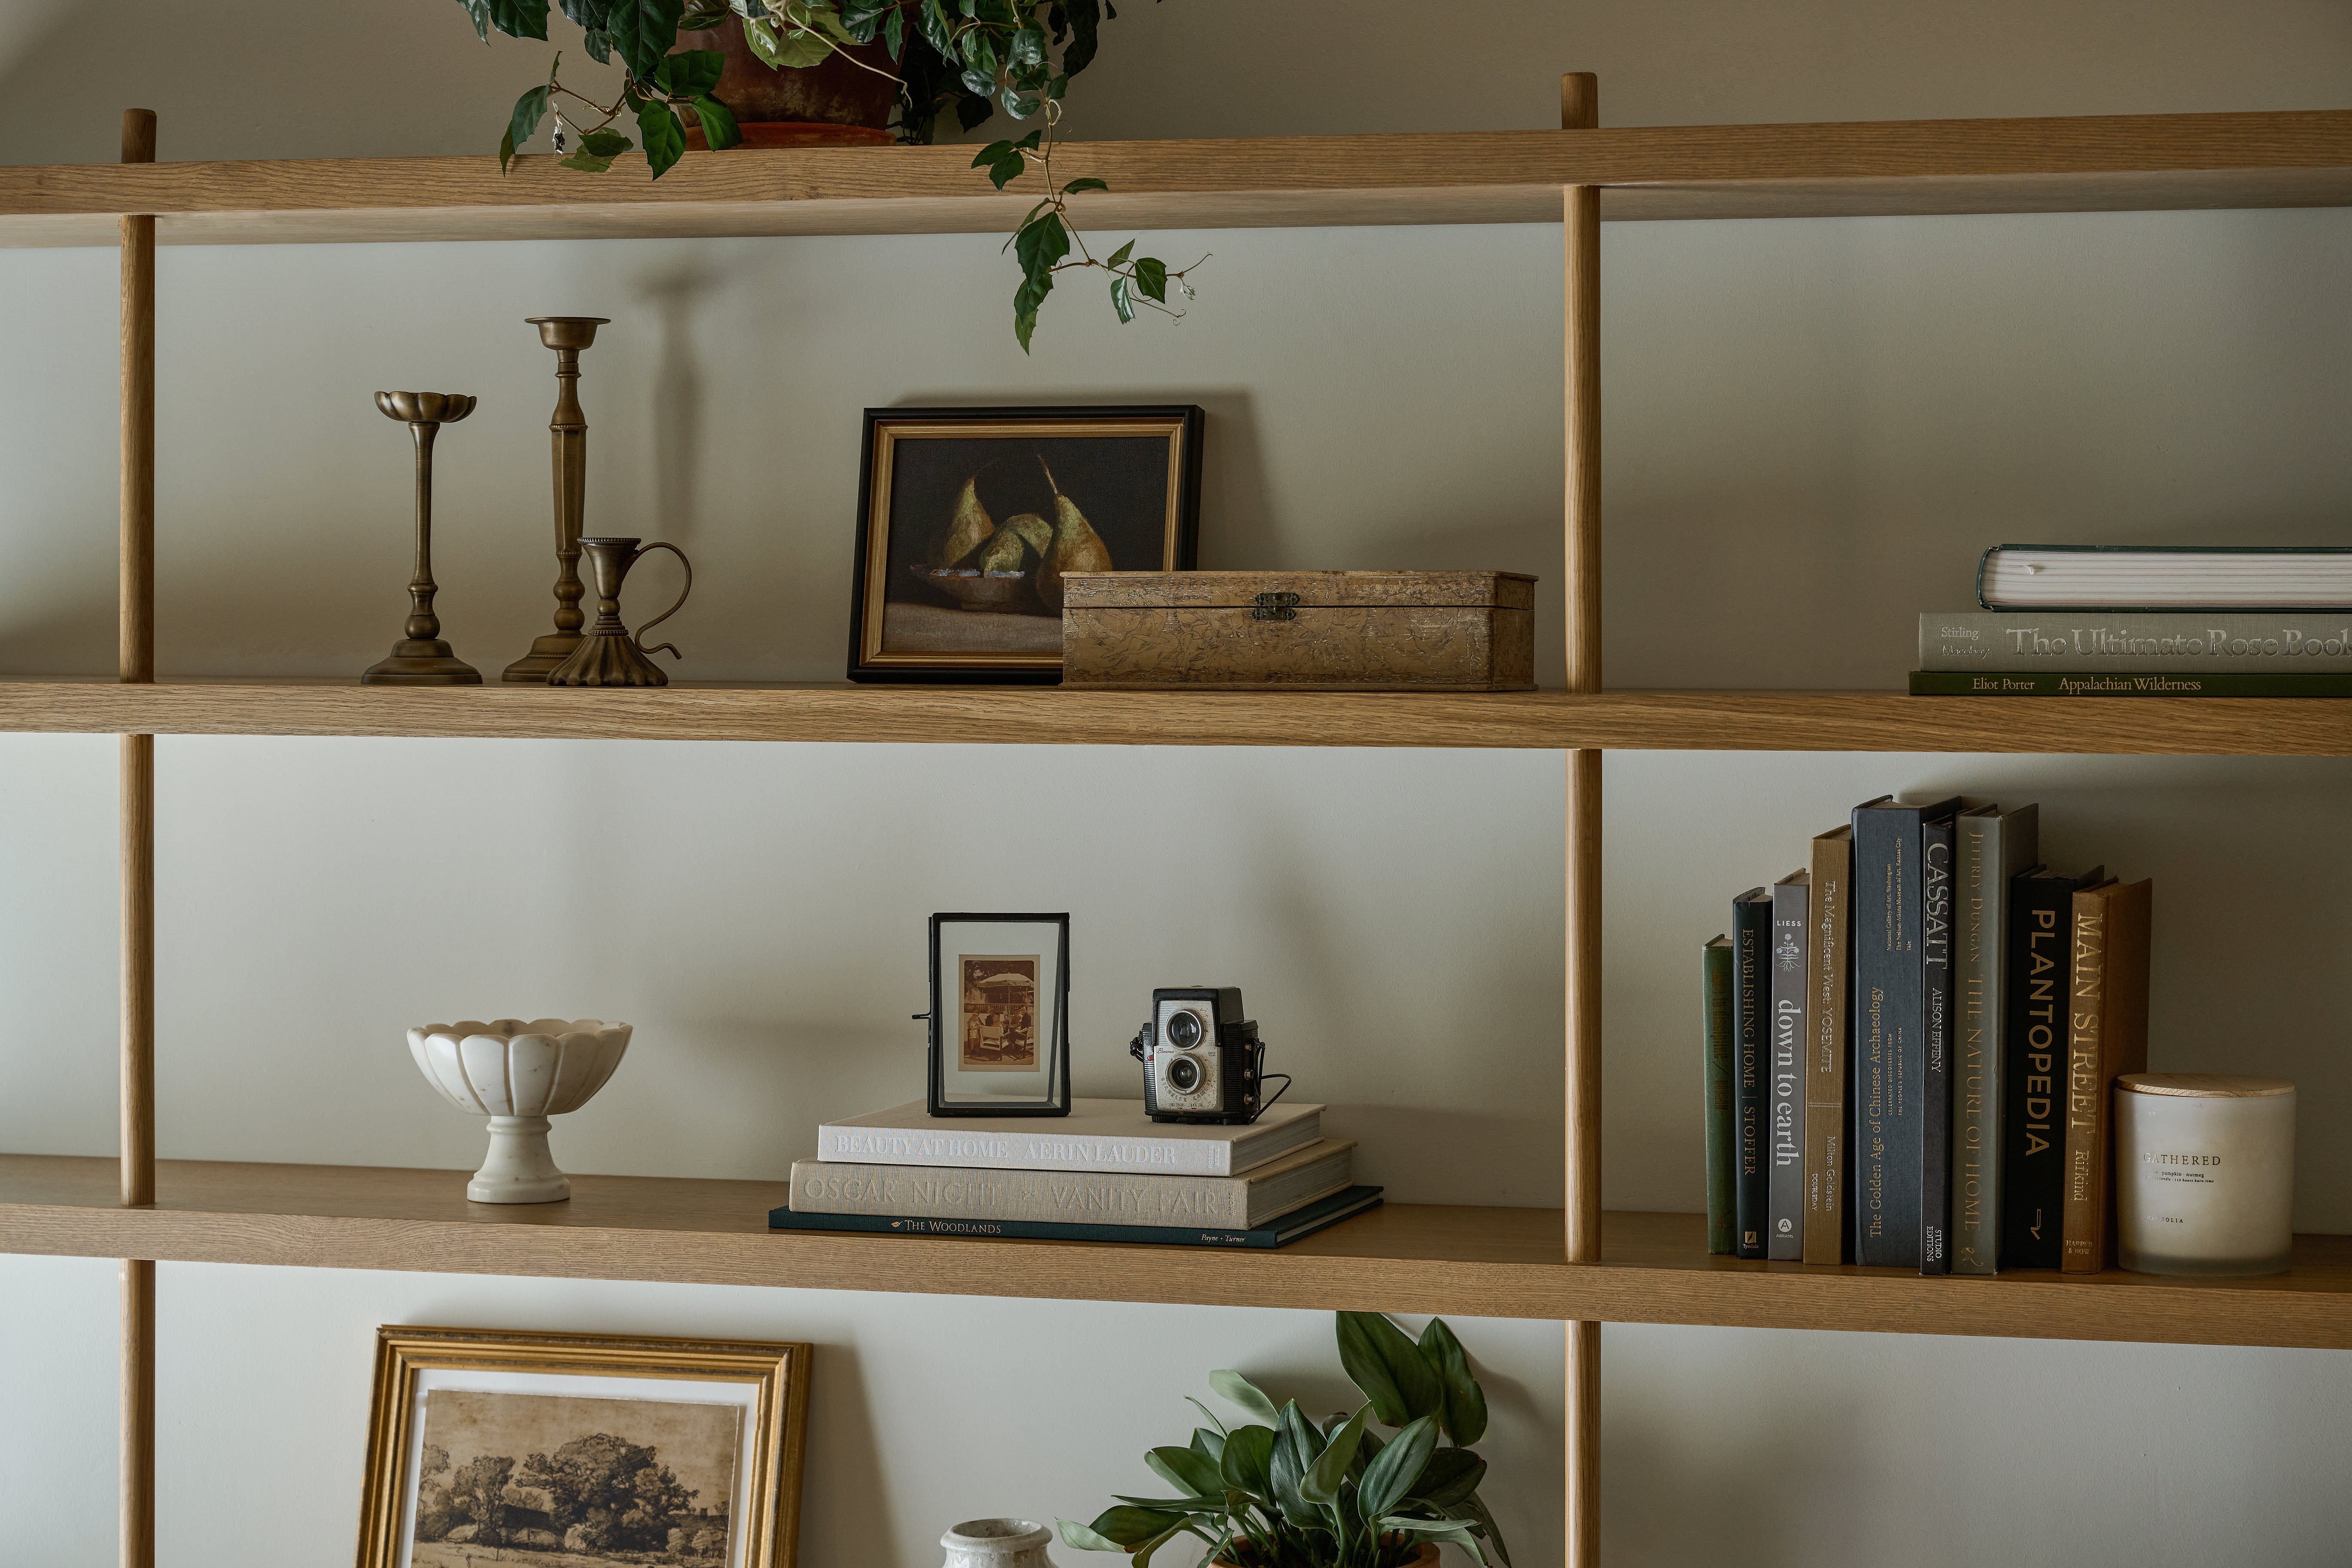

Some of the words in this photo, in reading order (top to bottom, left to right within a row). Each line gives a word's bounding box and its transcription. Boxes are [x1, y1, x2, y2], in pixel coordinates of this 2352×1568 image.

[1941, 627, 1978, 640] Stirling
[1942, 645, 1990, 660] Macoboy
[2007, 627, 2066, 656] The
[2072, 628, 2203, 657] Ultimate
[2208, 629, 2278, 657] Rose
[1973, 678, 1998, 691] Eliot
[2002, 678, 2035, 691] Porter
[2059, 677, 2133, 695] Appalachian
[2133, 678, 2202, 691] Wilderness
[1969, 831, 1984, 889] JEFFREY
[1825, 881, 1836, 902] The
[1926, 843, 1949, 970] CASSATT
[1821, 905, 1835, 970] Magnificent
[1970, 898, 1983, 962] DUNGAN
[2075, 913, 2103, 1001] MAIN
[1742, 929, 1755, 1040] ESTABLISHING
[1968, 974, 1983, 1020] THE
[1869, 986, 1884, 1063] Archaeology
[1932, 987, 1942, 1029] ALISON
[1778, 999, 1801, 1067] down
[1820, 1008, 1833, 1073] YOSEMITE
[1932, 1031, 1941, 1073] EFFENY
[2026, 910, 2056, 1156] PLANTOPEDIA
[1743, 1043, 1755, 1088] HOME
[1777, 1072, 1798, 1097] to
[1966, 1028, 1983, 1119] NATURE
[2071, 1013, 2099, 1134] STREET
[1869, 1067, 1881, 1117] Chinese
[836, 1135, 913, 1155] BEAUTY
[918, 1138, 944, 1155] AT
[947, 1139, 1008, 1158] HOME
[1743, 1106, 1756, 1176] STOFFER
[1776, 1102, 1799, 1166] earth
[1869, 1120, 1881, 1134] of
[1966, 1126, 1982, 1156] OF
[1023, 1142, 1089, 1161] AERIN
[1093, 1144, 1177, 1165] LAUDER
[1827, 1136, 1835, 1166] Milton
[1870, 1138, 1884, 1160] Age
[2143, 1152, 2221, 1166] GATHERED
[1826, 1169, 1835, 1211] Goldstein
[1870, 1164, 1882, 1210] Golden
[2071, 1149, 2090, 1201] Rifkind
[1051, 1186, 1146, 1211] VANITY
[1965, 1163, 1981, 1230] HOME
[904, 1220, 925, 1231] THE
[928, 1221, 1001, 1234] WOODLANDS
[1202, 1234, 1218, 1242] Payne
[1870, 1212, 1882, 1238] The
[2145, 1215, 2184, 1224] MAGNOLIA
